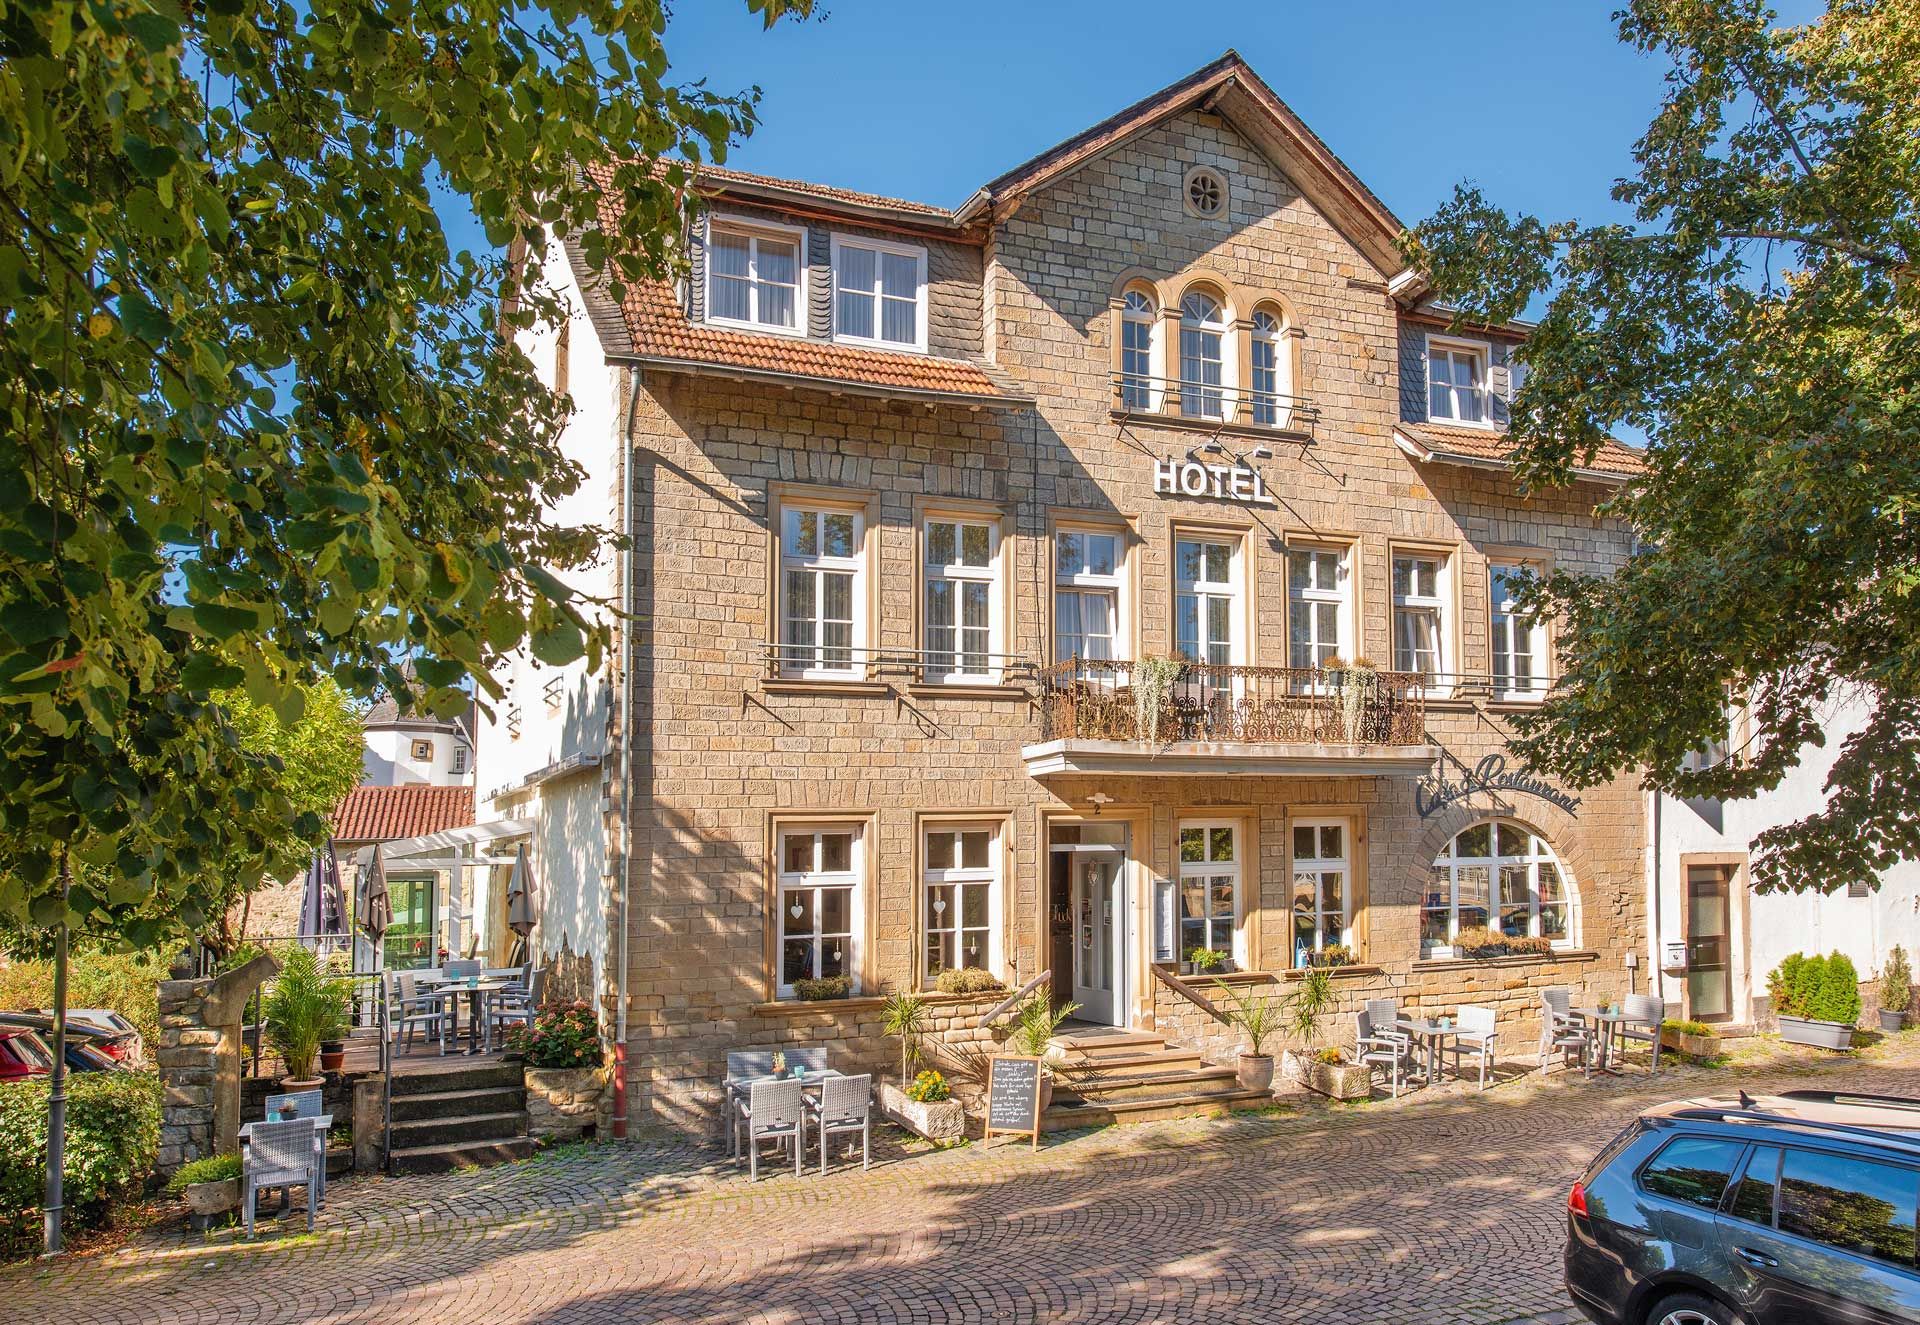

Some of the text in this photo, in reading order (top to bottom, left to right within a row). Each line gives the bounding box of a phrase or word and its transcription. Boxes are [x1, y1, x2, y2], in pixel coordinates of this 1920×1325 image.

[1153, 459, 1273, 503] HOTEL
[1475, 754, 1584, 812] Restaurant
[1094, 803, 1101, 815] 2
